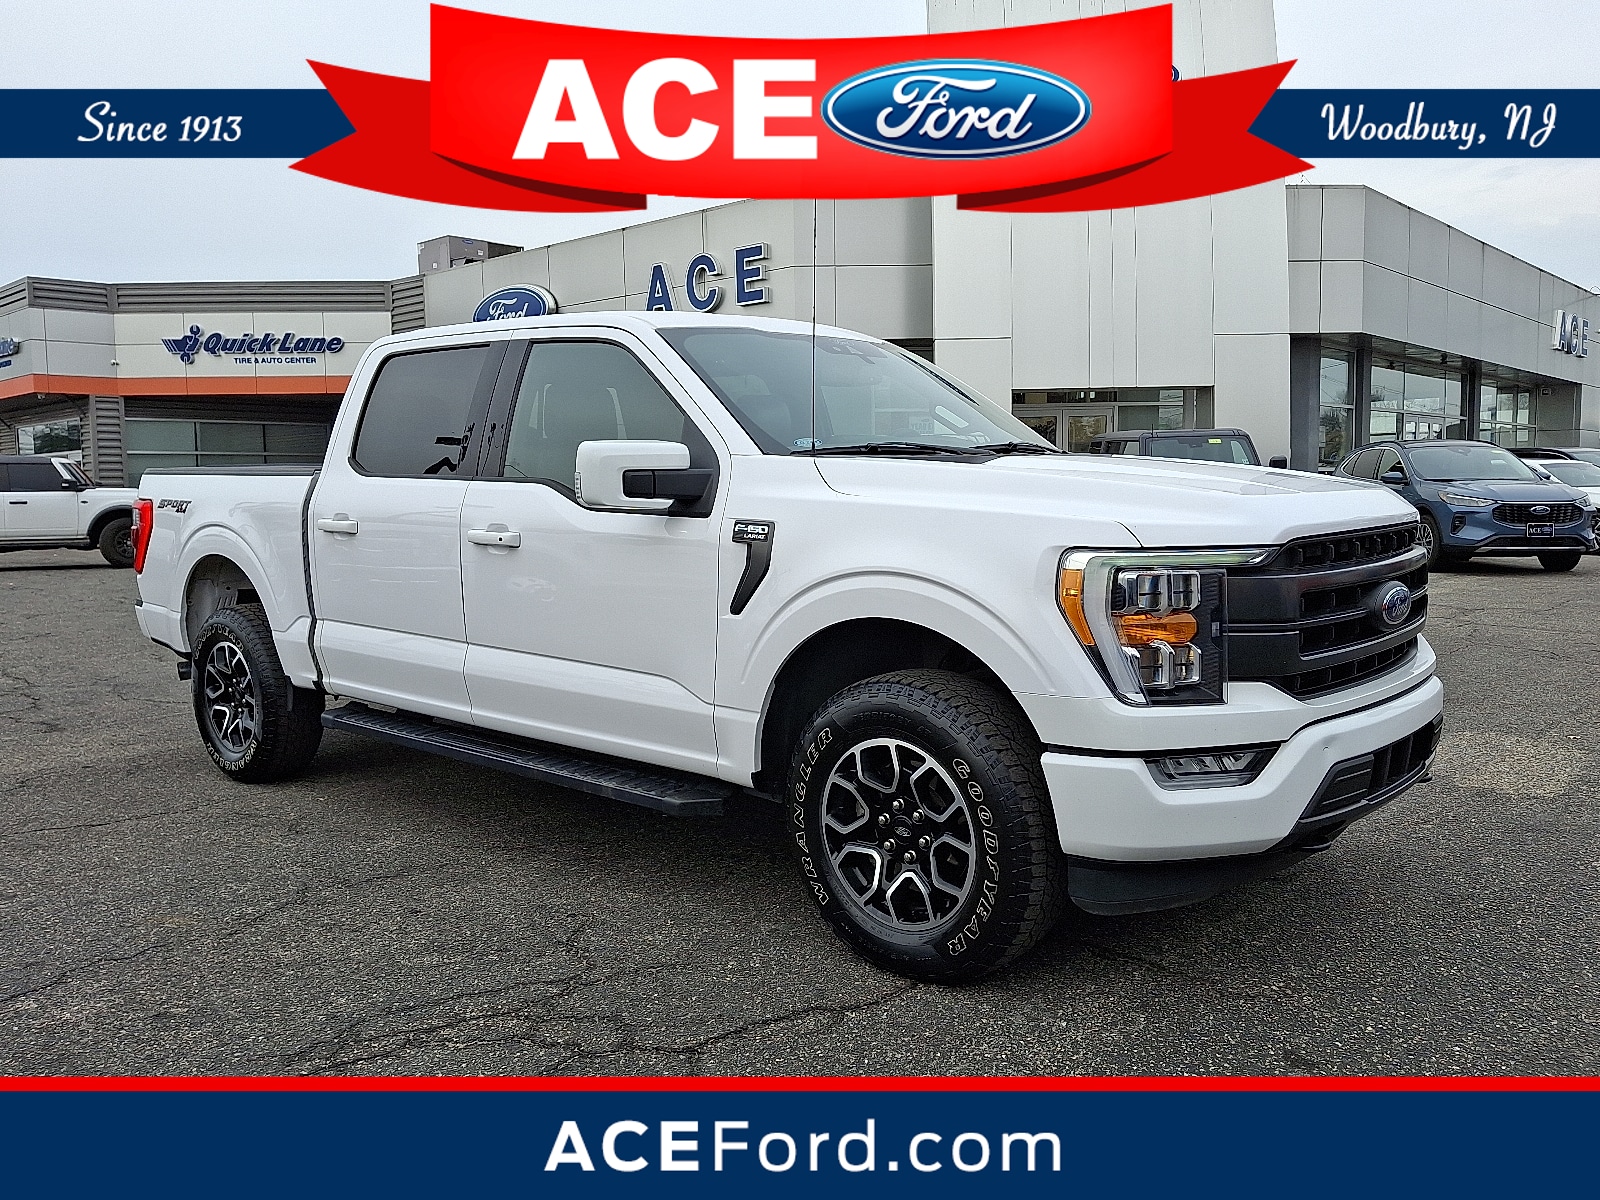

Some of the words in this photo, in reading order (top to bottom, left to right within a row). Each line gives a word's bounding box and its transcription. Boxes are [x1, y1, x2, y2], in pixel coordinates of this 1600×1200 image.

[645, 242, 770, 312] ACE
[485, 297, 528, 320] Ford
[1556, 310, 1589, 357] ACE
[157, 499, 192, 509] SPORT
[735, 524, 769, 533] F-150
[793, 727, 833, 905] WRANGLER
[947, 758, 1000, 955] GOODYEAR
